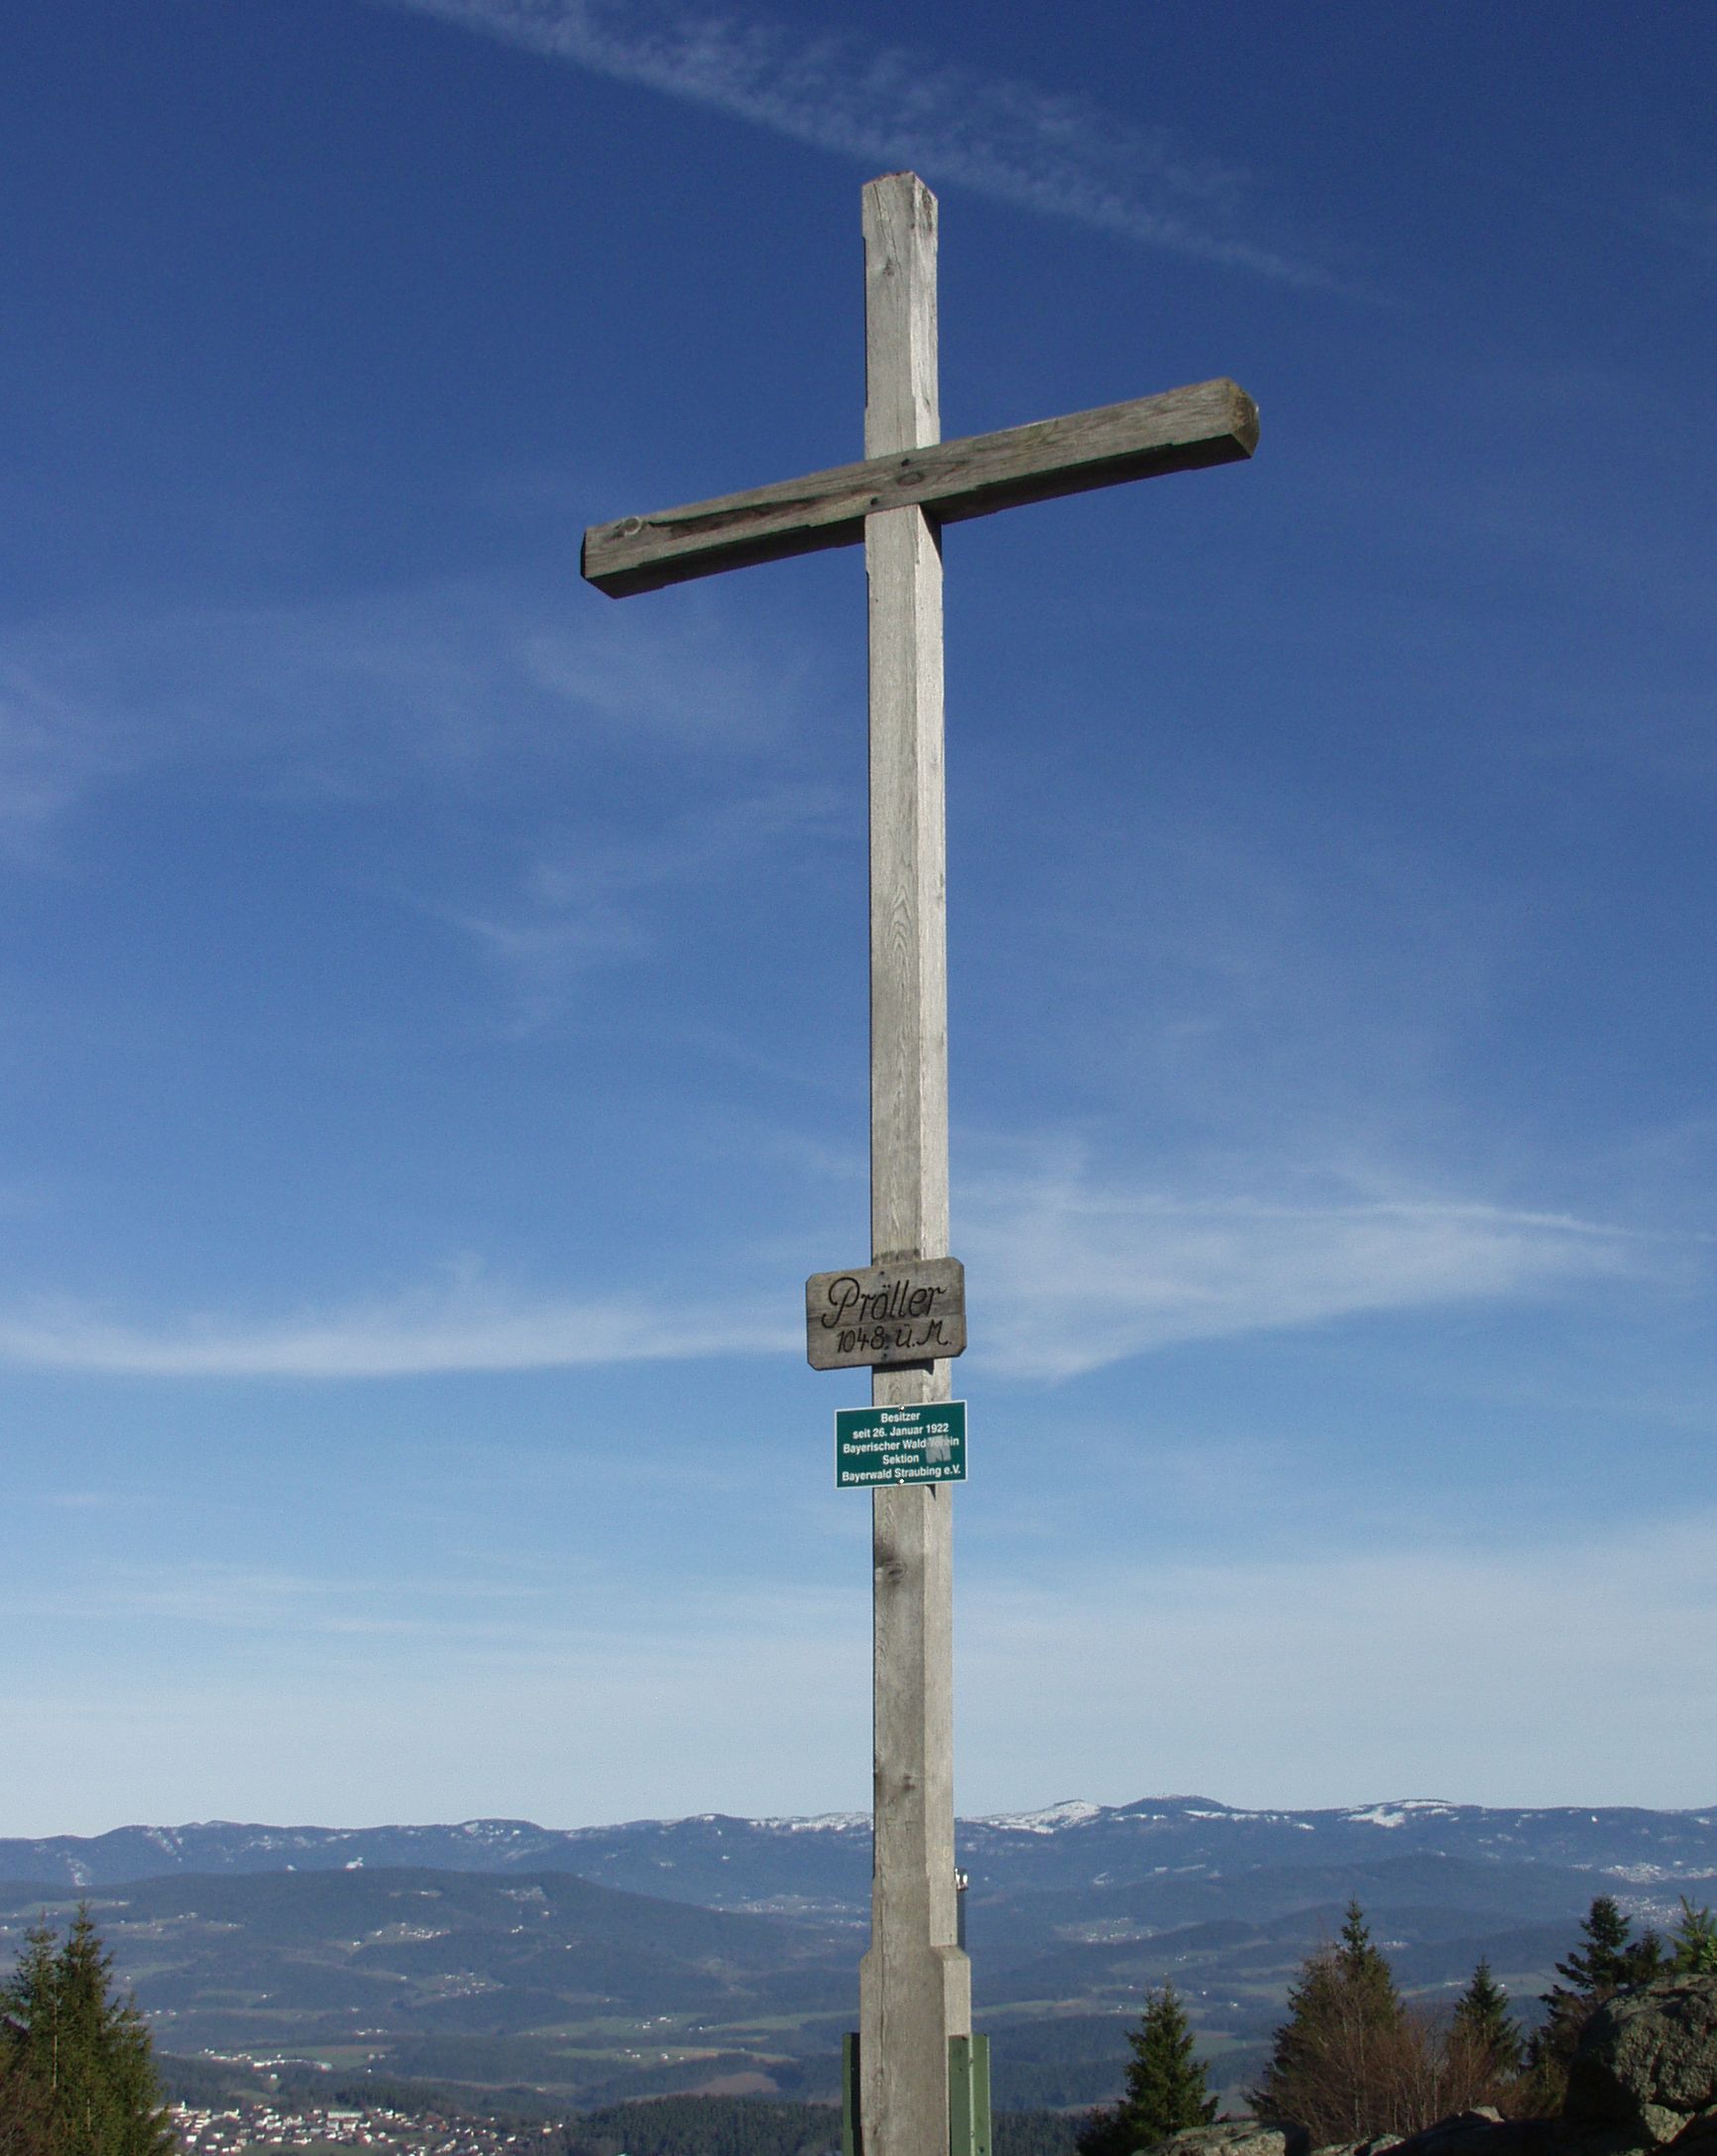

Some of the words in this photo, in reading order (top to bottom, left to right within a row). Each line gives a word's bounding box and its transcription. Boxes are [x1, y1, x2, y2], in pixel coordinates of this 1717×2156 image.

[821, 1276, 948, 1329] Pröller
[880, 1412, 921, 1423] Besitzer
[853, 1428, 870, 1440] seit
[872, 1426, 887, 1438] 26.
[889, 1424, 924, 1437] Januar
[926, 1422, 950, 1434] 1922
[843, 1440, 900, 1455] Bayerischer
[882, 1452, 920, 1465] Sektion
[842, 1467, 892, 1483] Bayerwald
[894, 1464, 942, 1479] Straubing
[944, 1463, 962, 1475] e.V.
